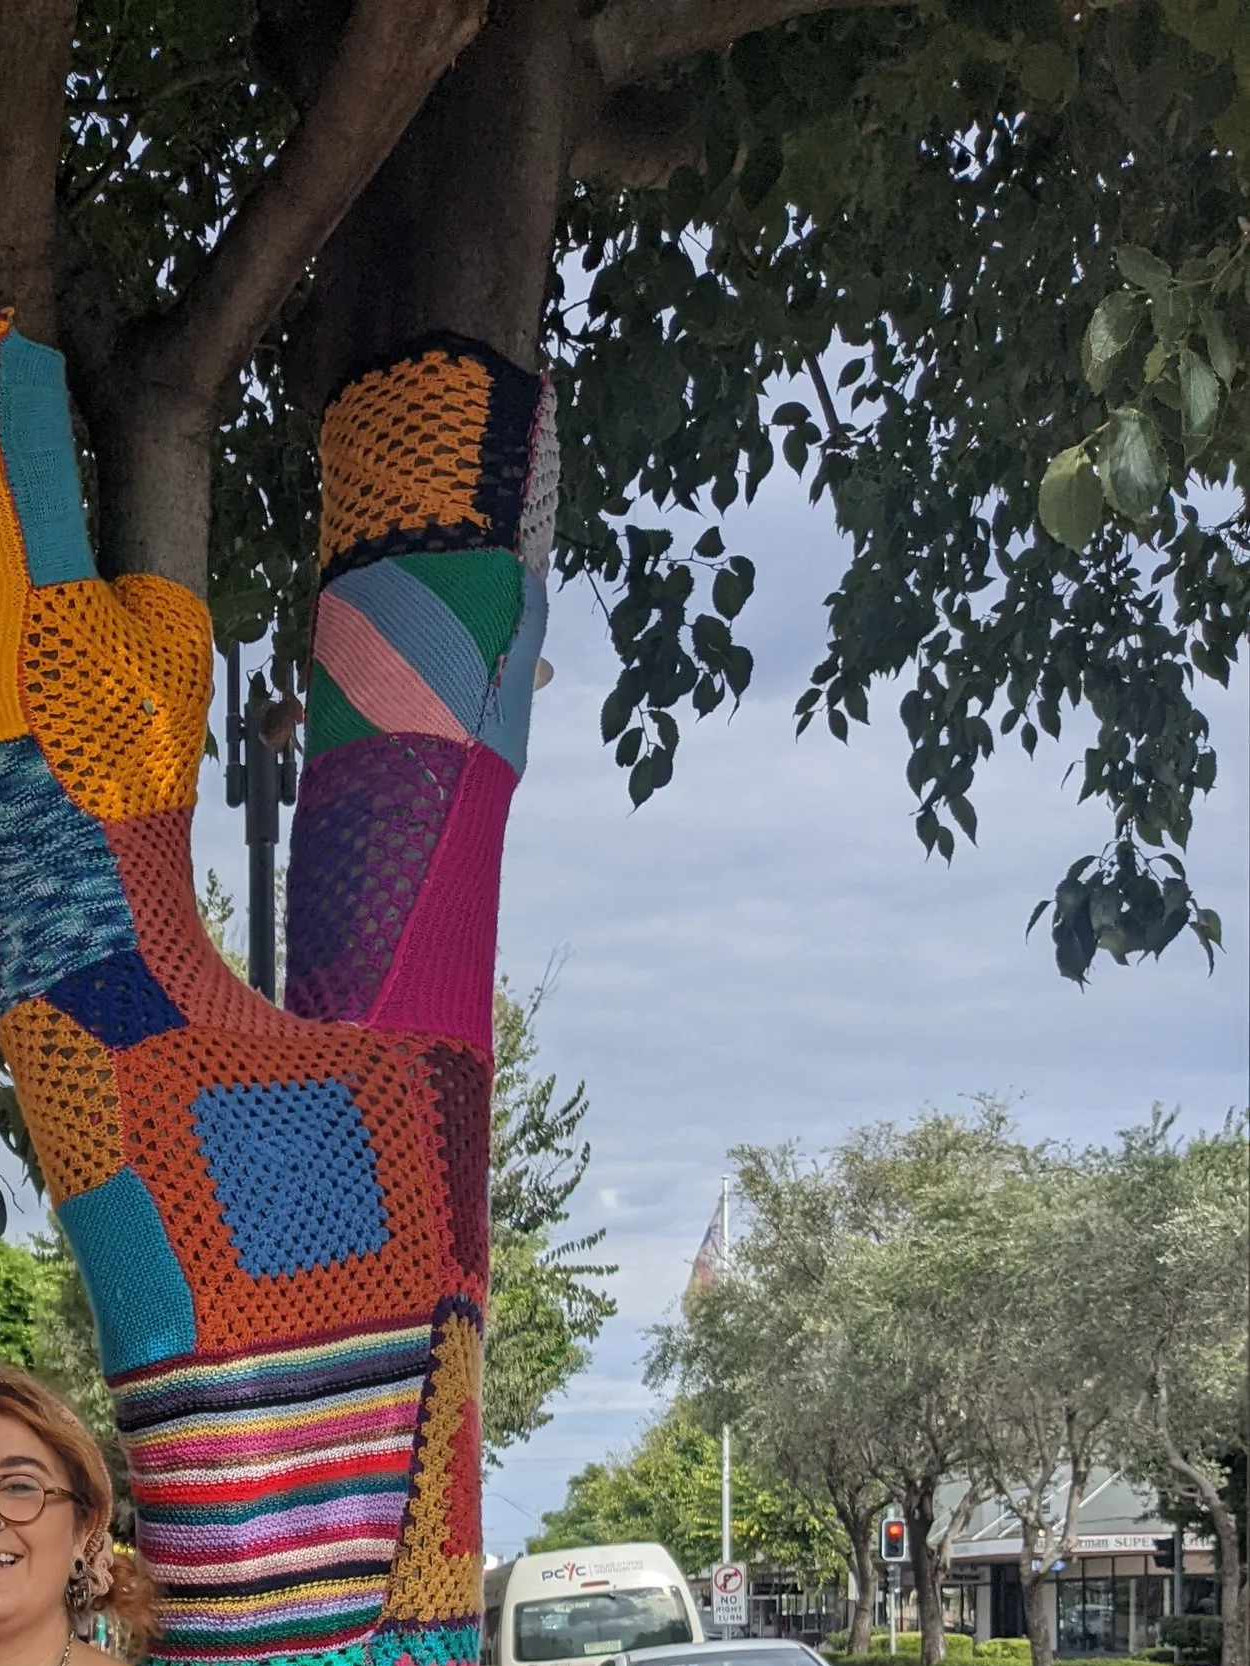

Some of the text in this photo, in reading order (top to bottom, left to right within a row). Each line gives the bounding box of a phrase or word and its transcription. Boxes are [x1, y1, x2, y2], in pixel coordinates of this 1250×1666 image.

[541, 1562, 587, 1582] PCYC
[720, 1595, 738, 1604] NO
[715, 1605, 743, 1614] RIGHT
[716, 1613, 743, 1622] TURN
